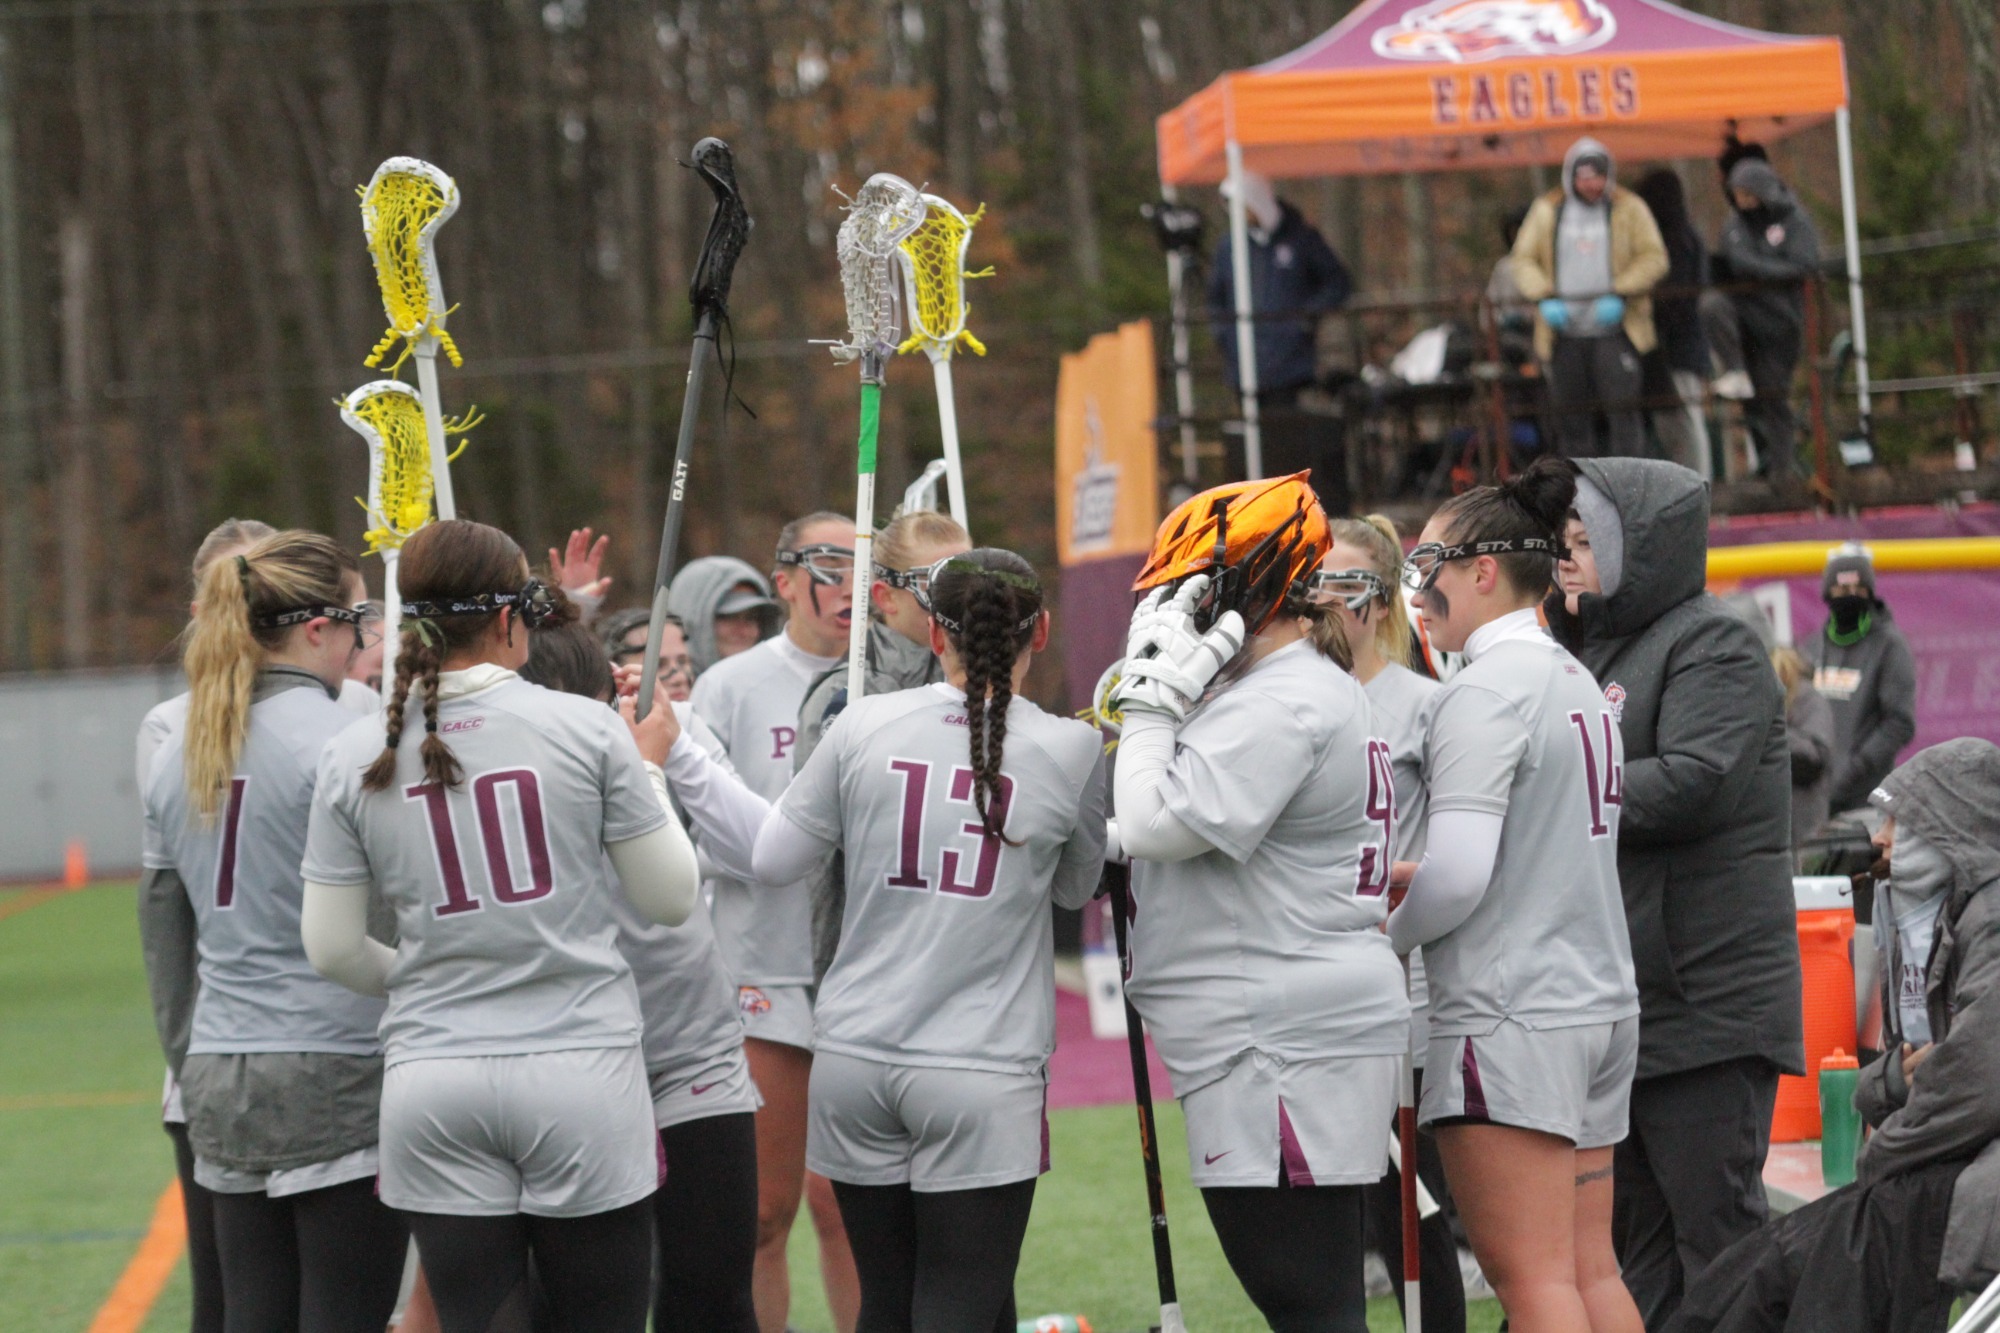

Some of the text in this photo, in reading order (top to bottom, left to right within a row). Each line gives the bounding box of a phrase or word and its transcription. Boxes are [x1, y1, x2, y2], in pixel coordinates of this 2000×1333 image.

[1433, 67, 1638, 123] EAGLES
[672, 459, 688, 501] GAIT
[1438, 538, 1548, 558] TX STX STX
[277, 606, 355, 625] STX STX
[857, 570, 869, 669] INFINITY PRO
[936, 611, 960, 631] STX
[442, 717, 483, 733] CACC
[1567, 710, 1624, 841] 14
[402, 766, 556, 920] 10
[884, 756, 1018, 901] 13
